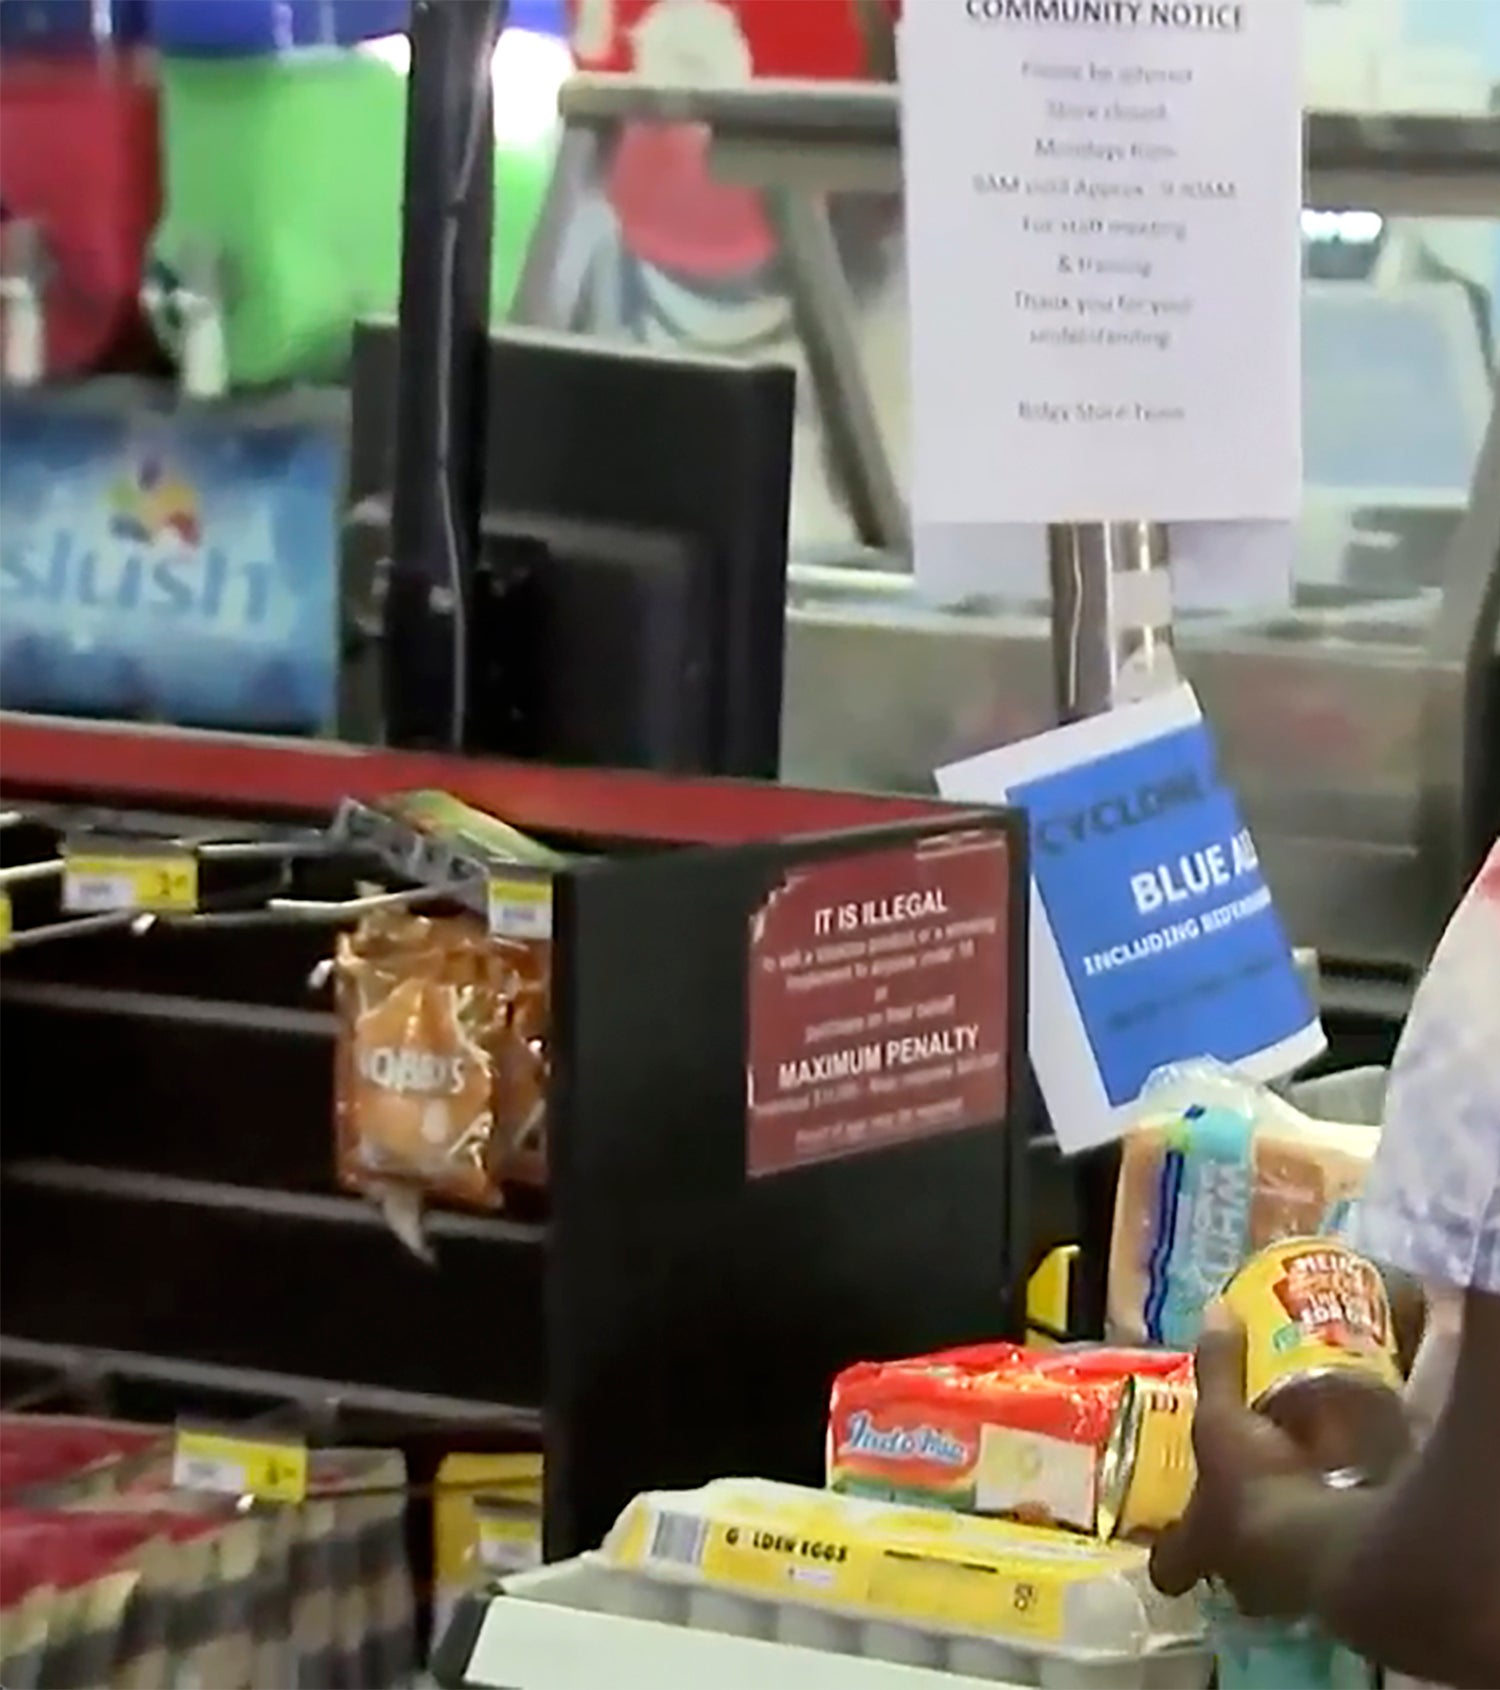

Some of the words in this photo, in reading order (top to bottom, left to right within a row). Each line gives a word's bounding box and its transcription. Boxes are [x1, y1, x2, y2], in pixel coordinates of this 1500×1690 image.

[965, 0, 1139, 25] COMMUNITY
[1151, 1, 1244, 30] NOTICE
[1129, 843, 1230, 915] BLUE
[814, 906, 832, 935] IT
[838, 902, 858, 931] IS
[861, 887, 948, 926] ILLEGAL
[1082, 916, 1199, 976] INCLUDING
[778, 1044, 881, 1090] MAXIMUM
[886, 1024, 979, 1067] PENALTY
[799, 1538, 849, 1564] EGGS
